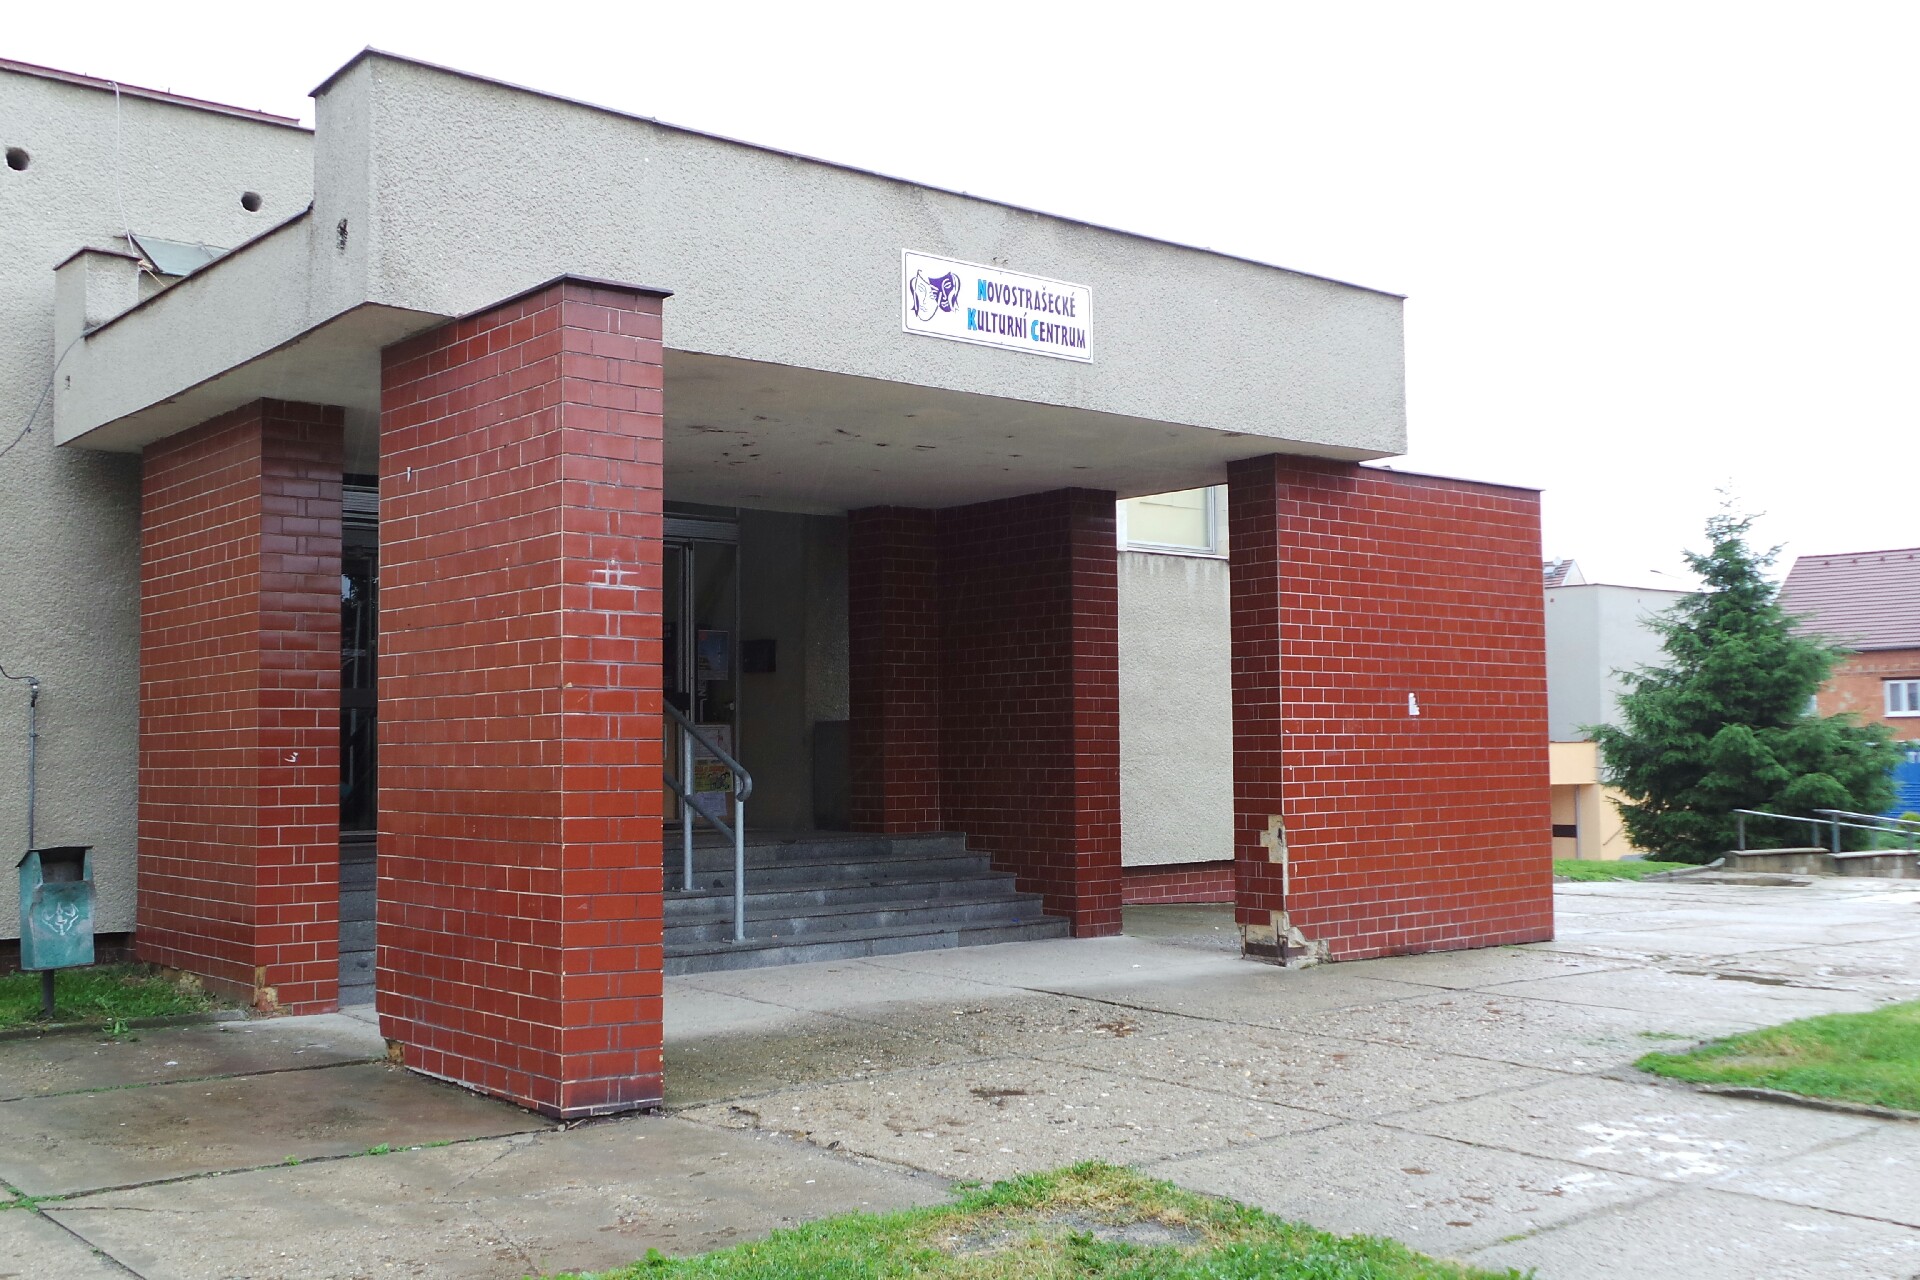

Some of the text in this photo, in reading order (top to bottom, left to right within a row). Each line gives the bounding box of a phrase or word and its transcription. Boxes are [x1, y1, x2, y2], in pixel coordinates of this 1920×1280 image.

[977, 278, 1076, 318] NOVOSTRAŠECKÉ
[967, 307, 1086, 349] KULTURNÍ CENTRUM
